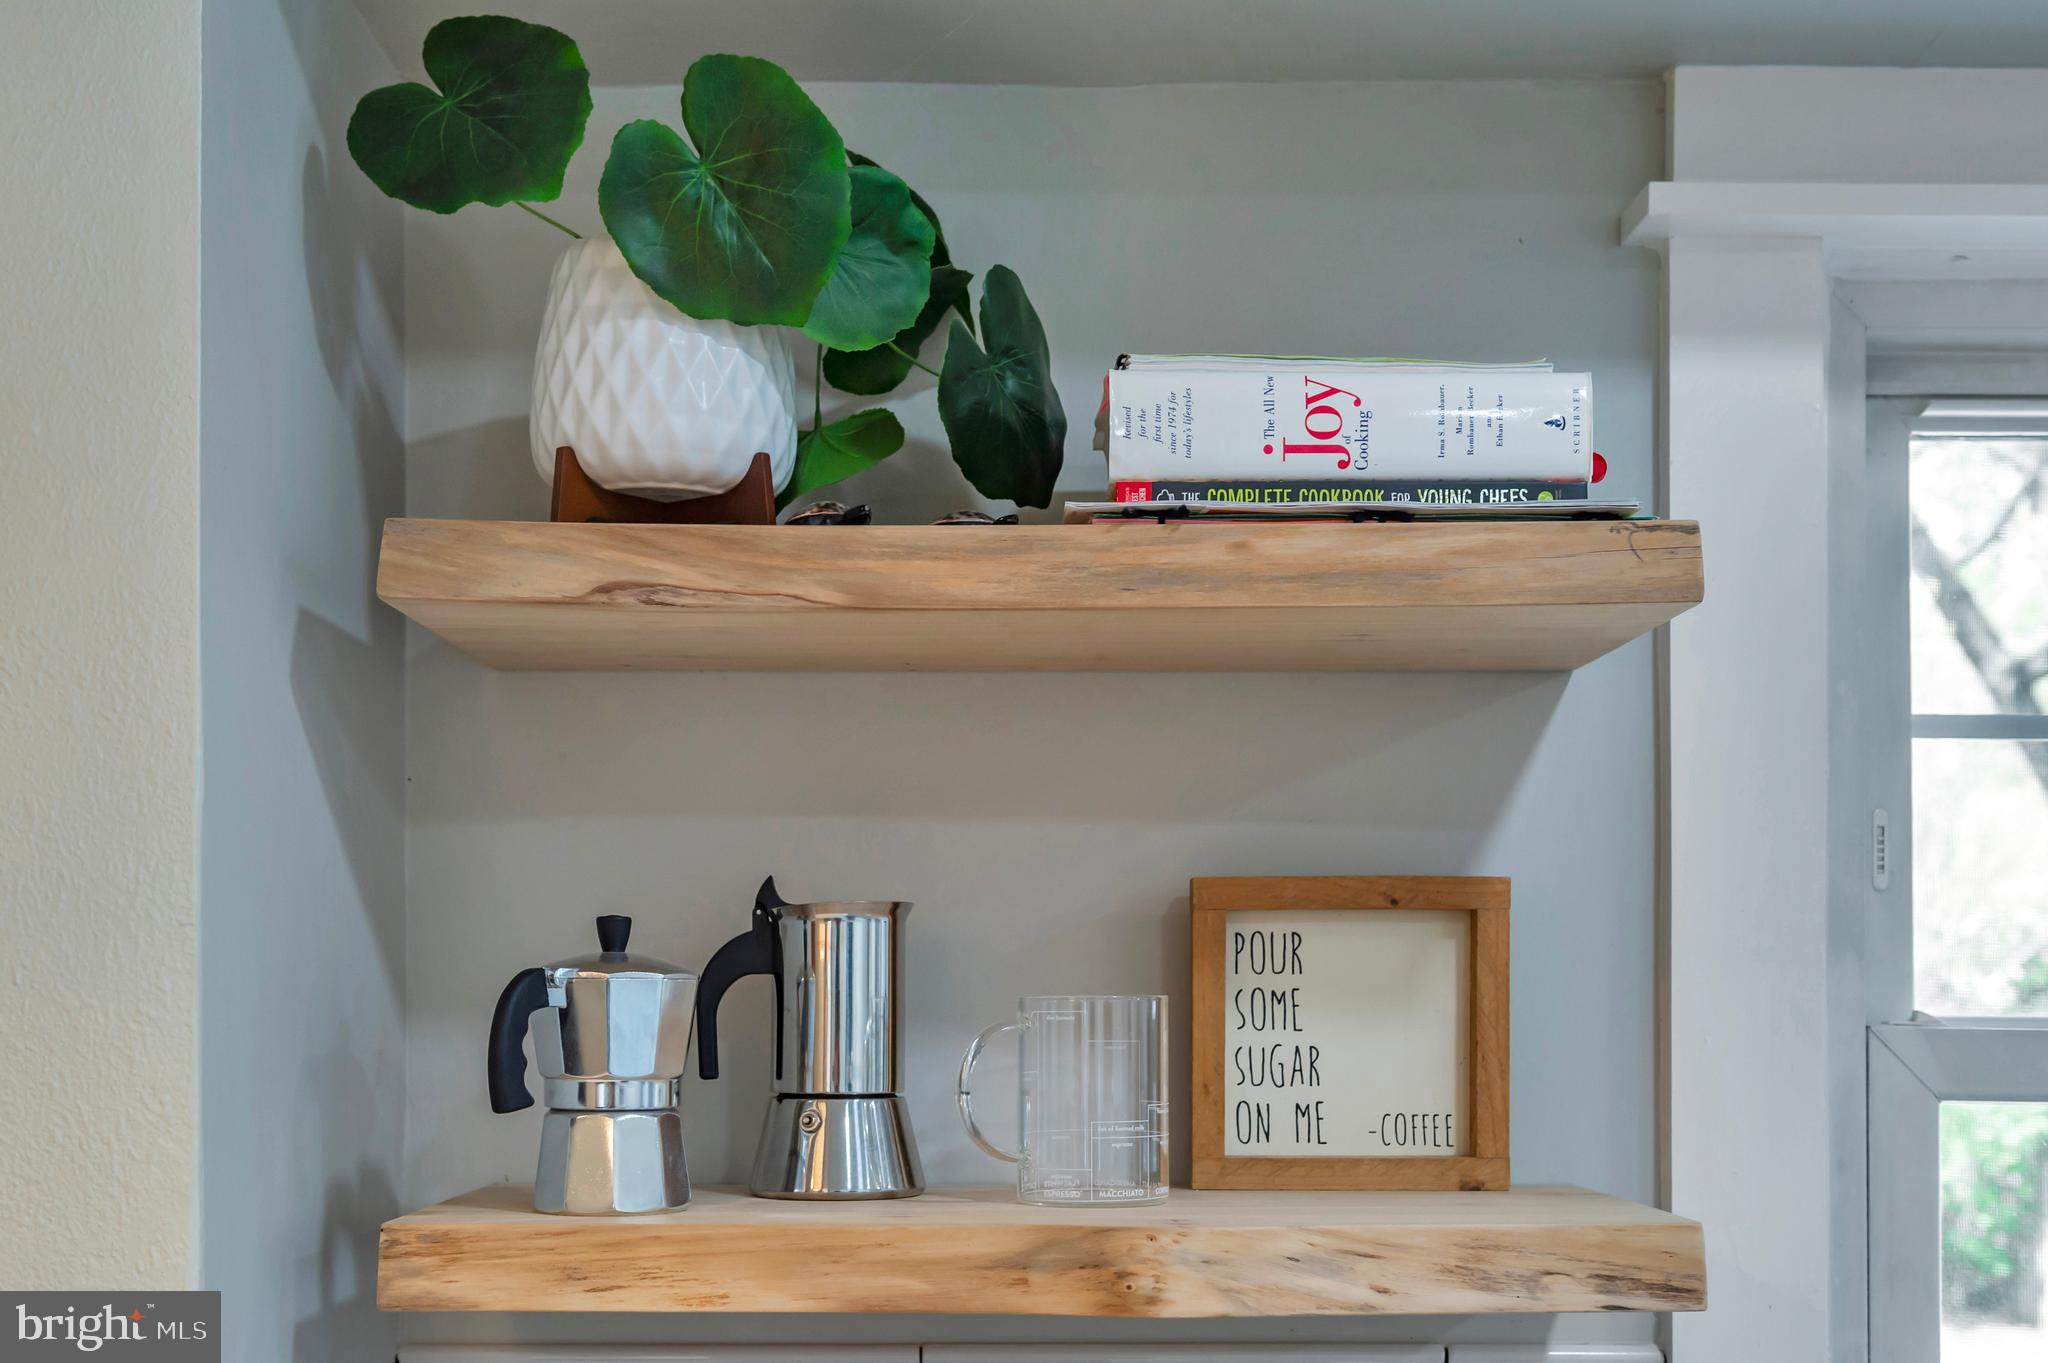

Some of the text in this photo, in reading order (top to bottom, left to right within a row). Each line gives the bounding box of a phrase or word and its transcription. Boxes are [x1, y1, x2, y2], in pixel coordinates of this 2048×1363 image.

[1137, 408, 1149, 439] for the
[1153, 403, 1164, 445] first time
[1167, 391, 1179, 455] since 1974 for
[1182, 387, 1194, 459] today's lifestyles
[1263, 375, 1275, 440] The All New
[1455, 406, 1463, 434] Marin
[1572, 388, 1581, 455] SCRIBNER
[1342, 435, 1351, 445] of
[1353, 410, 1373, 471] Cooking
[1437, 438, 1445, 459] Irma
[1466, 416, 1474, 455] Rombauer
[1495, 423, 1503, 447] Ethan
[1181, 488, 1529, 504] THE COMPLETE COOKBOOK FOR YOUNG CHEFS
[1234, 930, 1303, 976] POUR
[1234, 986, 1303, 1032] SOME
[1234, 1043, 1321, 1089] SUGAR
[1235, 1099, 1328, 1145] ON ME
[1368, 1112, 1455, 1148] -COFFEE
[1098, 1188, 1145, 1199] MACCHIATO
